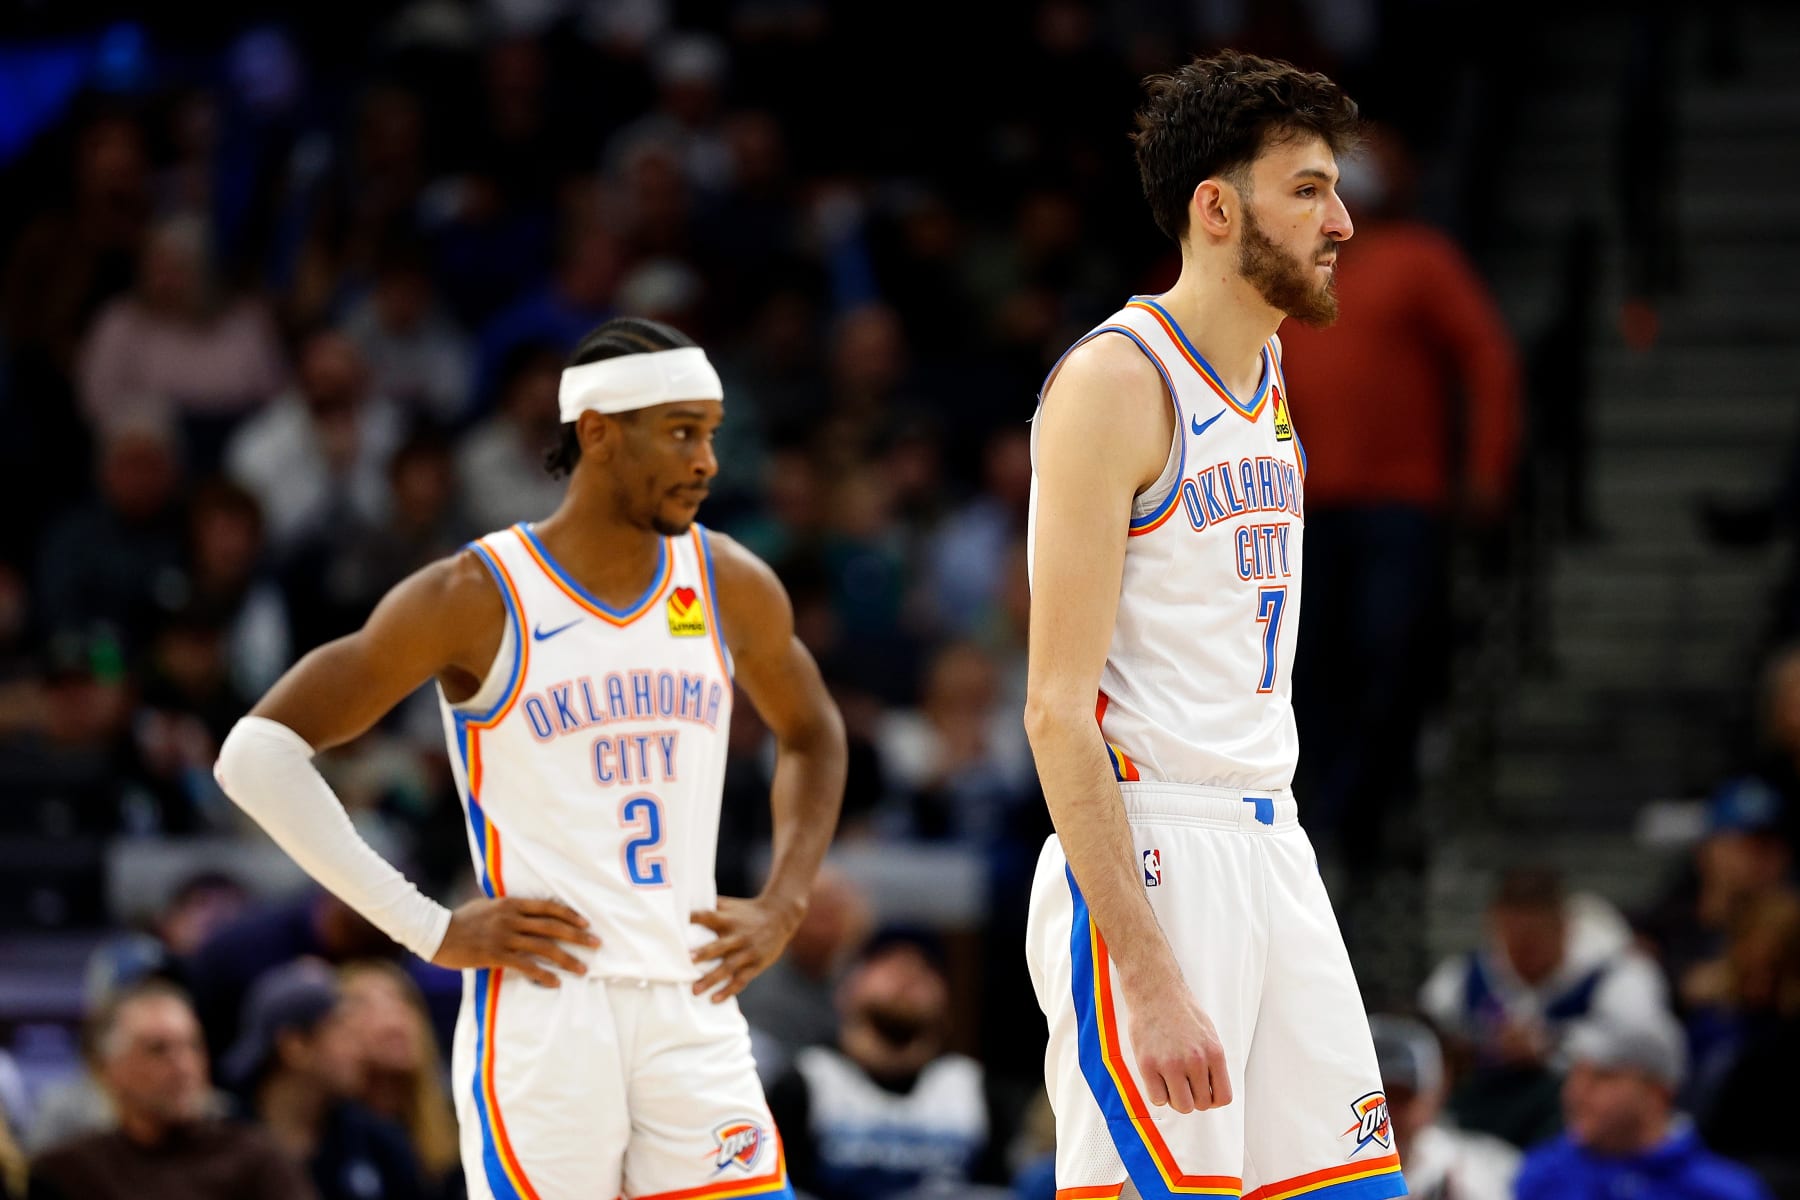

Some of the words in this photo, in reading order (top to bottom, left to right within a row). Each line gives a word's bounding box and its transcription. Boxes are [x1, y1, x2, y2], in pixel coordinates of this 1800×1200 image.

[1182, 457, 1304, 532] OKLAHOM
[1235, 523, 1291, 581] CITY
[1255, 584, 1287, 694] 7
[522, 670, 723, 743] OKLAHOMA
[592, 730, 680, 787] CITY
[619, 792, 671, 889] 2
